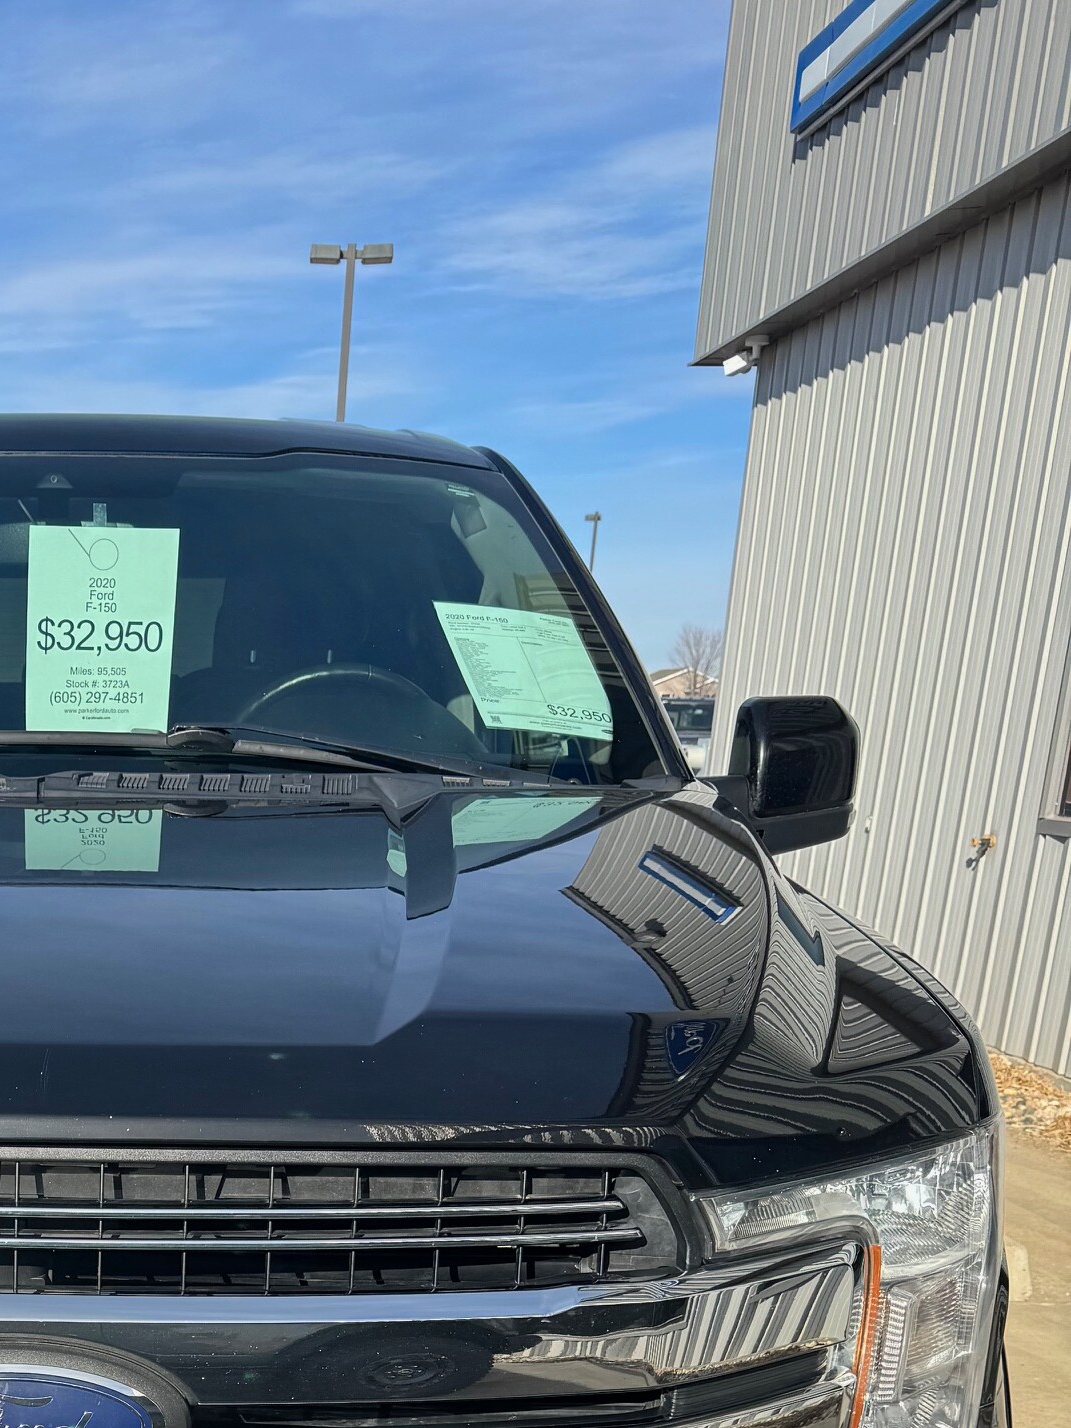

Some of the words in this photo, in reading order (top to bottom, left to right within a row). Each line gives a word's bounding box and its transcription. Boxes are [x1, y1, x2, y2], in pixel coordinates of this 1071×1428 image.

[89, 577, 116, 589] 2020
[89, 590, 114, 600] Ford
[86, 602, 117, 613] F-150
[36, 616, 163, 656] $32,950
[69, 667, 95, 676] Miles:
[97, 667, 127, 676] 95,505
[65, 679, 90, 688] Stock
[91, 680, 100, 688] #:
[102, 680, 130, 688] 3723A
[49, 691, 82, 706] (605)
[85, 691, 144, 704] 297-4851
[546, 704, 612, 723] $32,950
